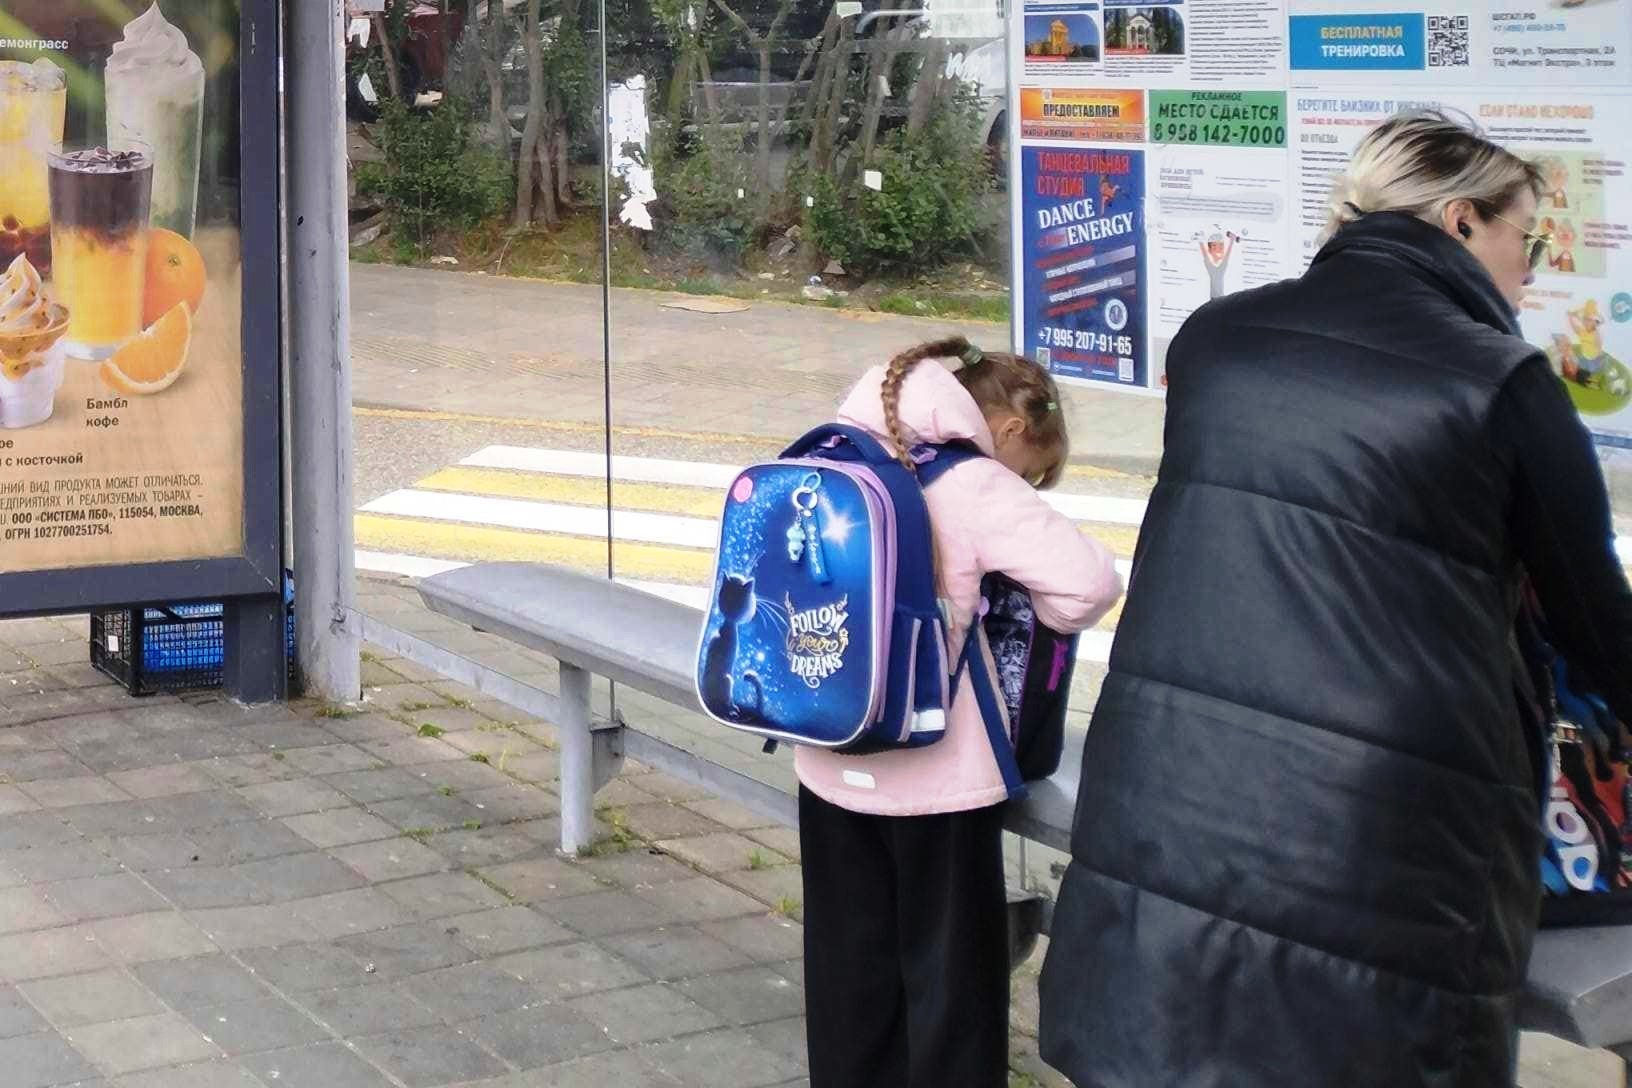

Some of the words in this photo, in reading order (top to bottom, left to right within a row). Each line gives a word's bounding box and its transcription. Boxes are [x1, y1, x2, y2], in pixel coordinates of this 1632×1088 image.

[1321, 25, 1403, 40] БЕСПЛАТНАЯ
[1321, 43, 1405, 58] ТРЕНИРОВКА
[1192, 91, 1242, 101] РЕКЛАМНОЕ
[1043, 102, 1120, 119] ПРЕДОСТАВЛЯЕМ
[1158, 103, 1207, 119] МЕСТО
[1210, 104, 1279, 123] СДАЕТСЯ
[1153, 123, 1163, 141] 8
[1203, 125, 1285, 145] 142-7000
[1037, 152, 1131, 174] ТАНЦЕВАЛЬНАЯ
[1037, 175, 1085, 197] СТУДИЯ
[1038, 198, 1096, 229] DANCE
[1067, 212, 1135, 246] ENERGY
[1038, 326, 1051, 345] +7
[1052, 327, 1074, 348] 995
[1074, 330, 1133, 356] 207-91-65
[86, 398, 129, 410] Бамбл
[86, 415, 119, 428] кофе
[5, 457, 13, 466] с
[16, 452, 84, 466] косточкой
[29, 480, 50, 494] ВИД
[54, 478, 101, 493] ПРОДУКТА
[105, 476, 139, 490] МОЖЕТ
[143, 474, 203, 488] ОТЛИЧАТЬСЯ.
[67, 495, 74, 506] И
[79, 490, 148, 506] РЕАЛИЗУЕМЫХ
[152, 490, 192, 503] ТОВАРАХ
[11, 512, 32, 524] ООО
[35, 509, 86, 524] «СИСТЕМА
[119, 506, 157, 519] 115054,
[159, 505, 203, 518] МОСКВА,
[4, 527, 31, 540] ОГРН
[790, 604, 849, 636] FOLLOW
[798, 632, 839, 654] your
[791, 653, 843, 681] DREAMS
